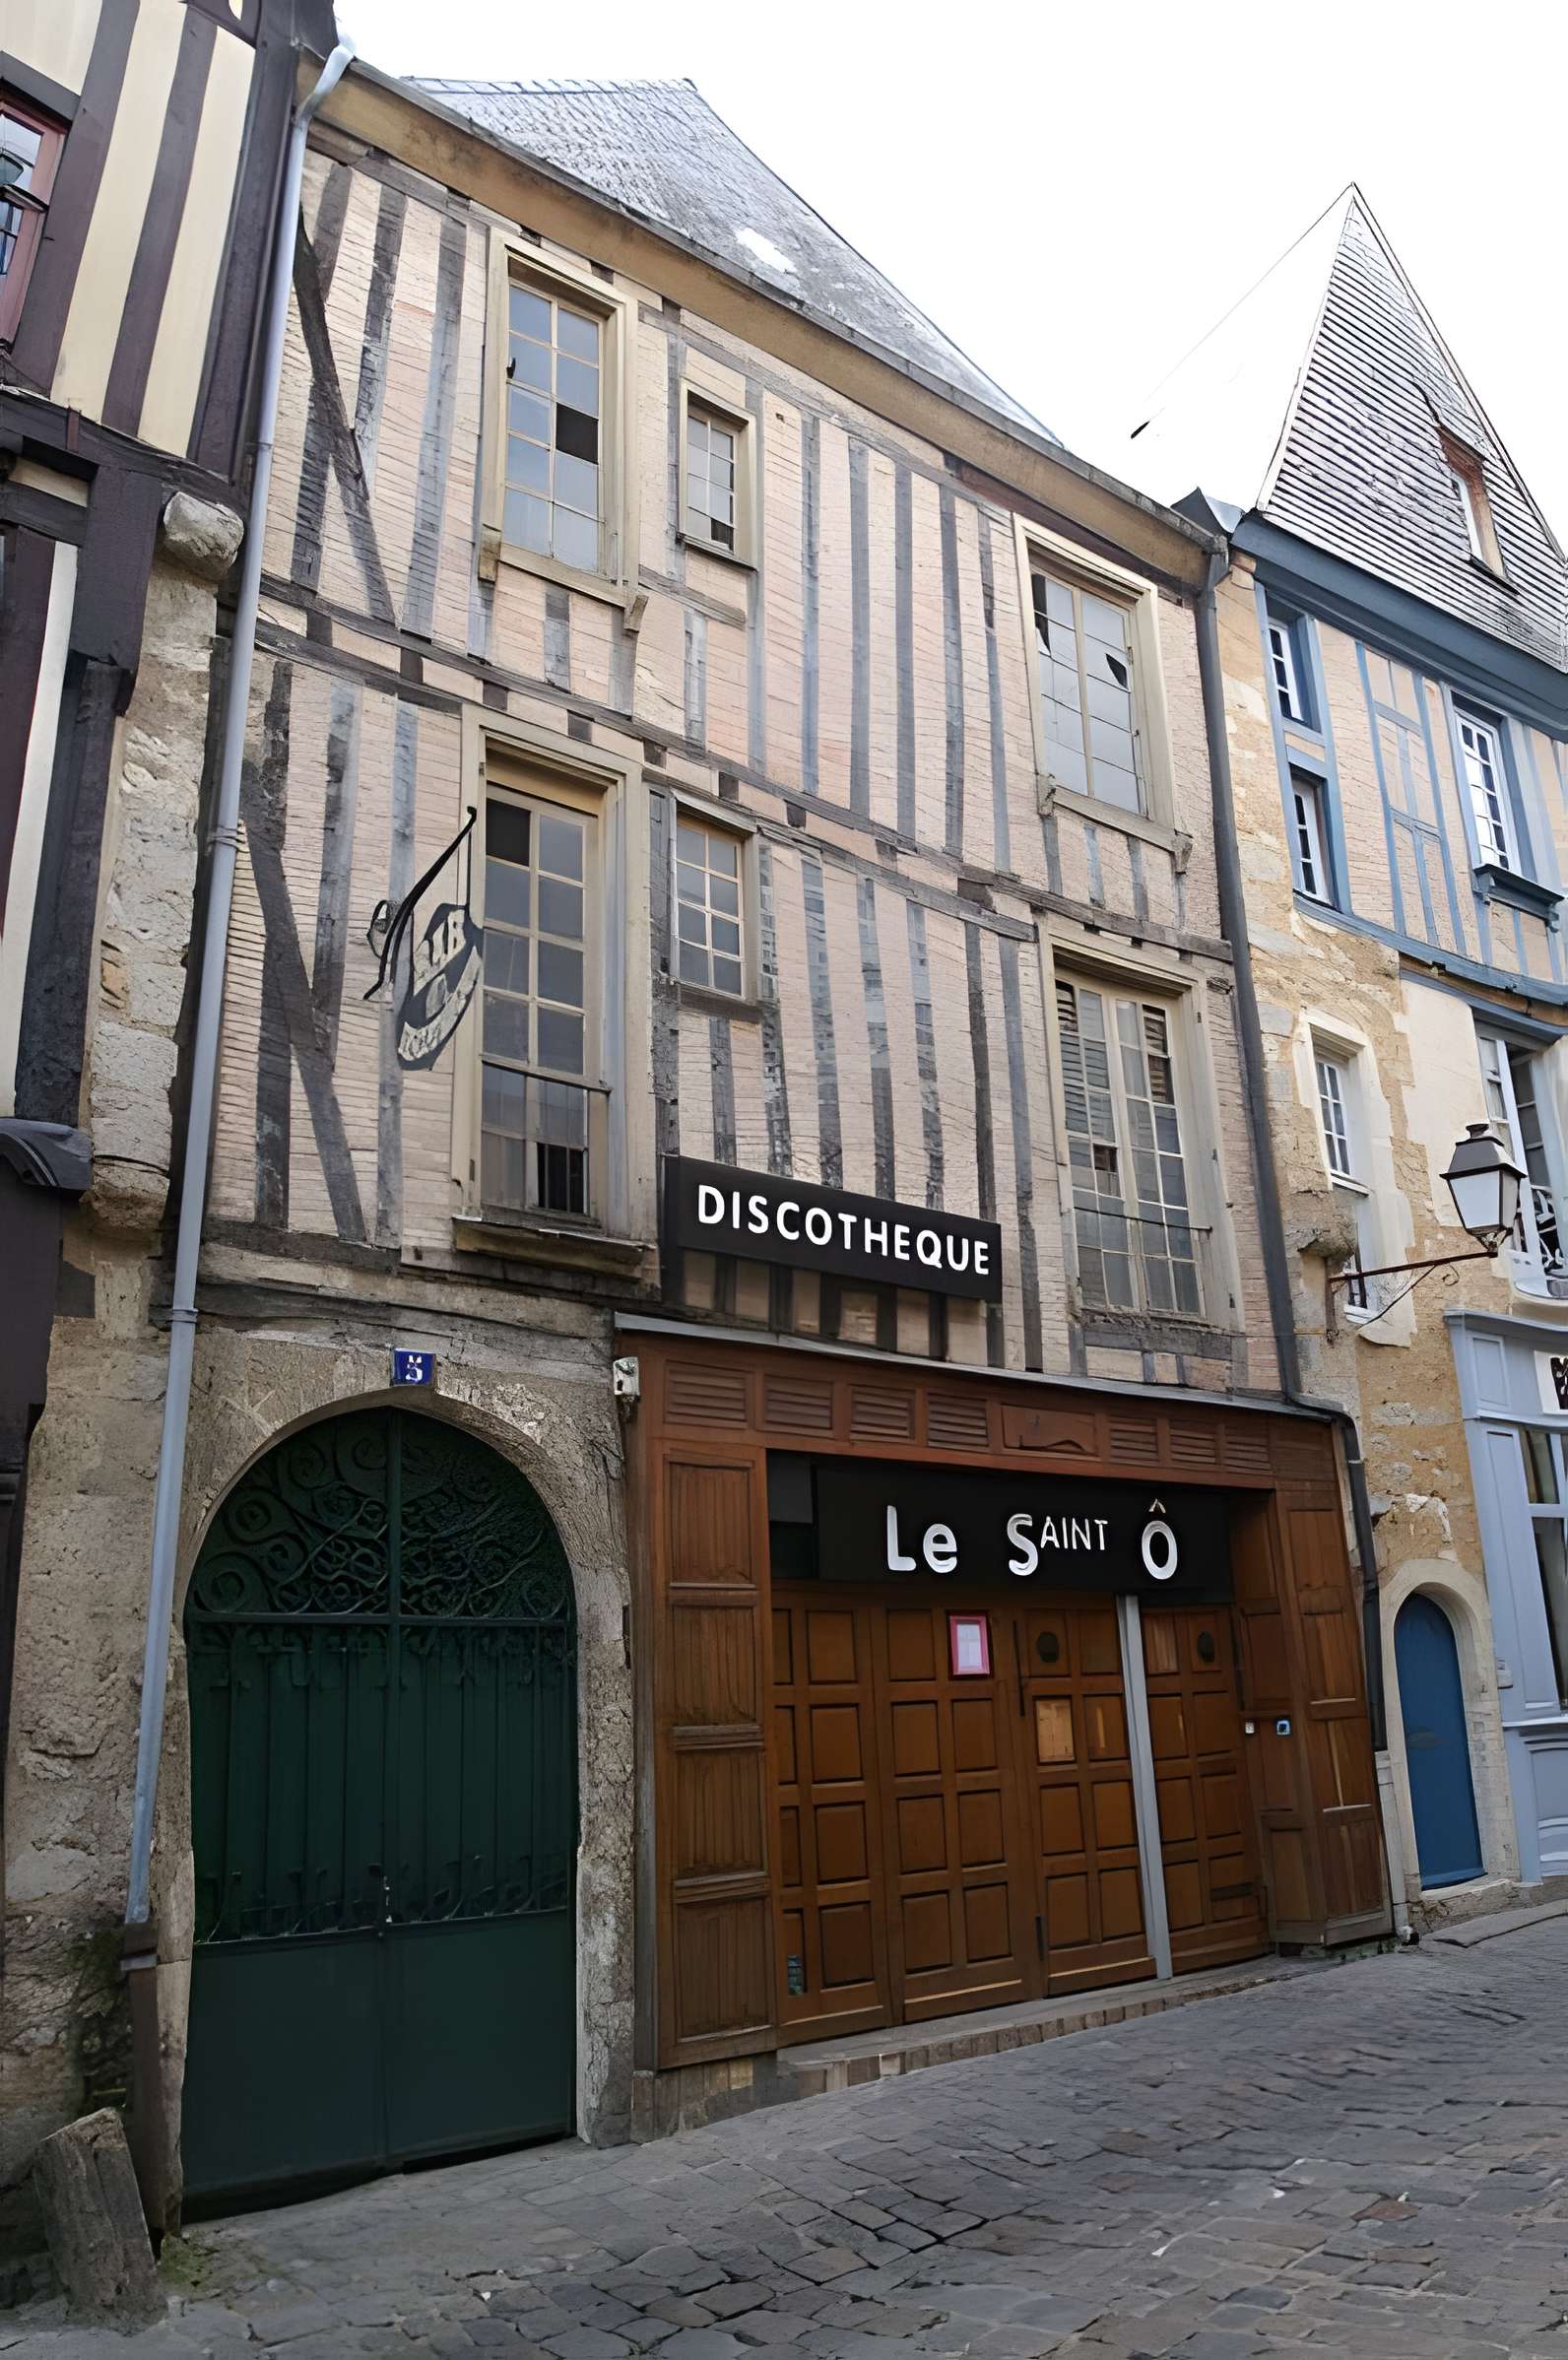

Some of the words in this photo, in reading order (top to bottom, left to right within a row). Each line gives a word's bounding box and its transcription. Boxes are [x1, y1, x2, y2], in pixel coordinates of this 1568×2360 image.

[697, 1184, 990, 1276] DISCOTHEQUE
[886, 1505, 957, 1574] Le
[1007, 1513, 1109, 1576] SAINT
[1142, 1498, 1178, 1580] Ô
